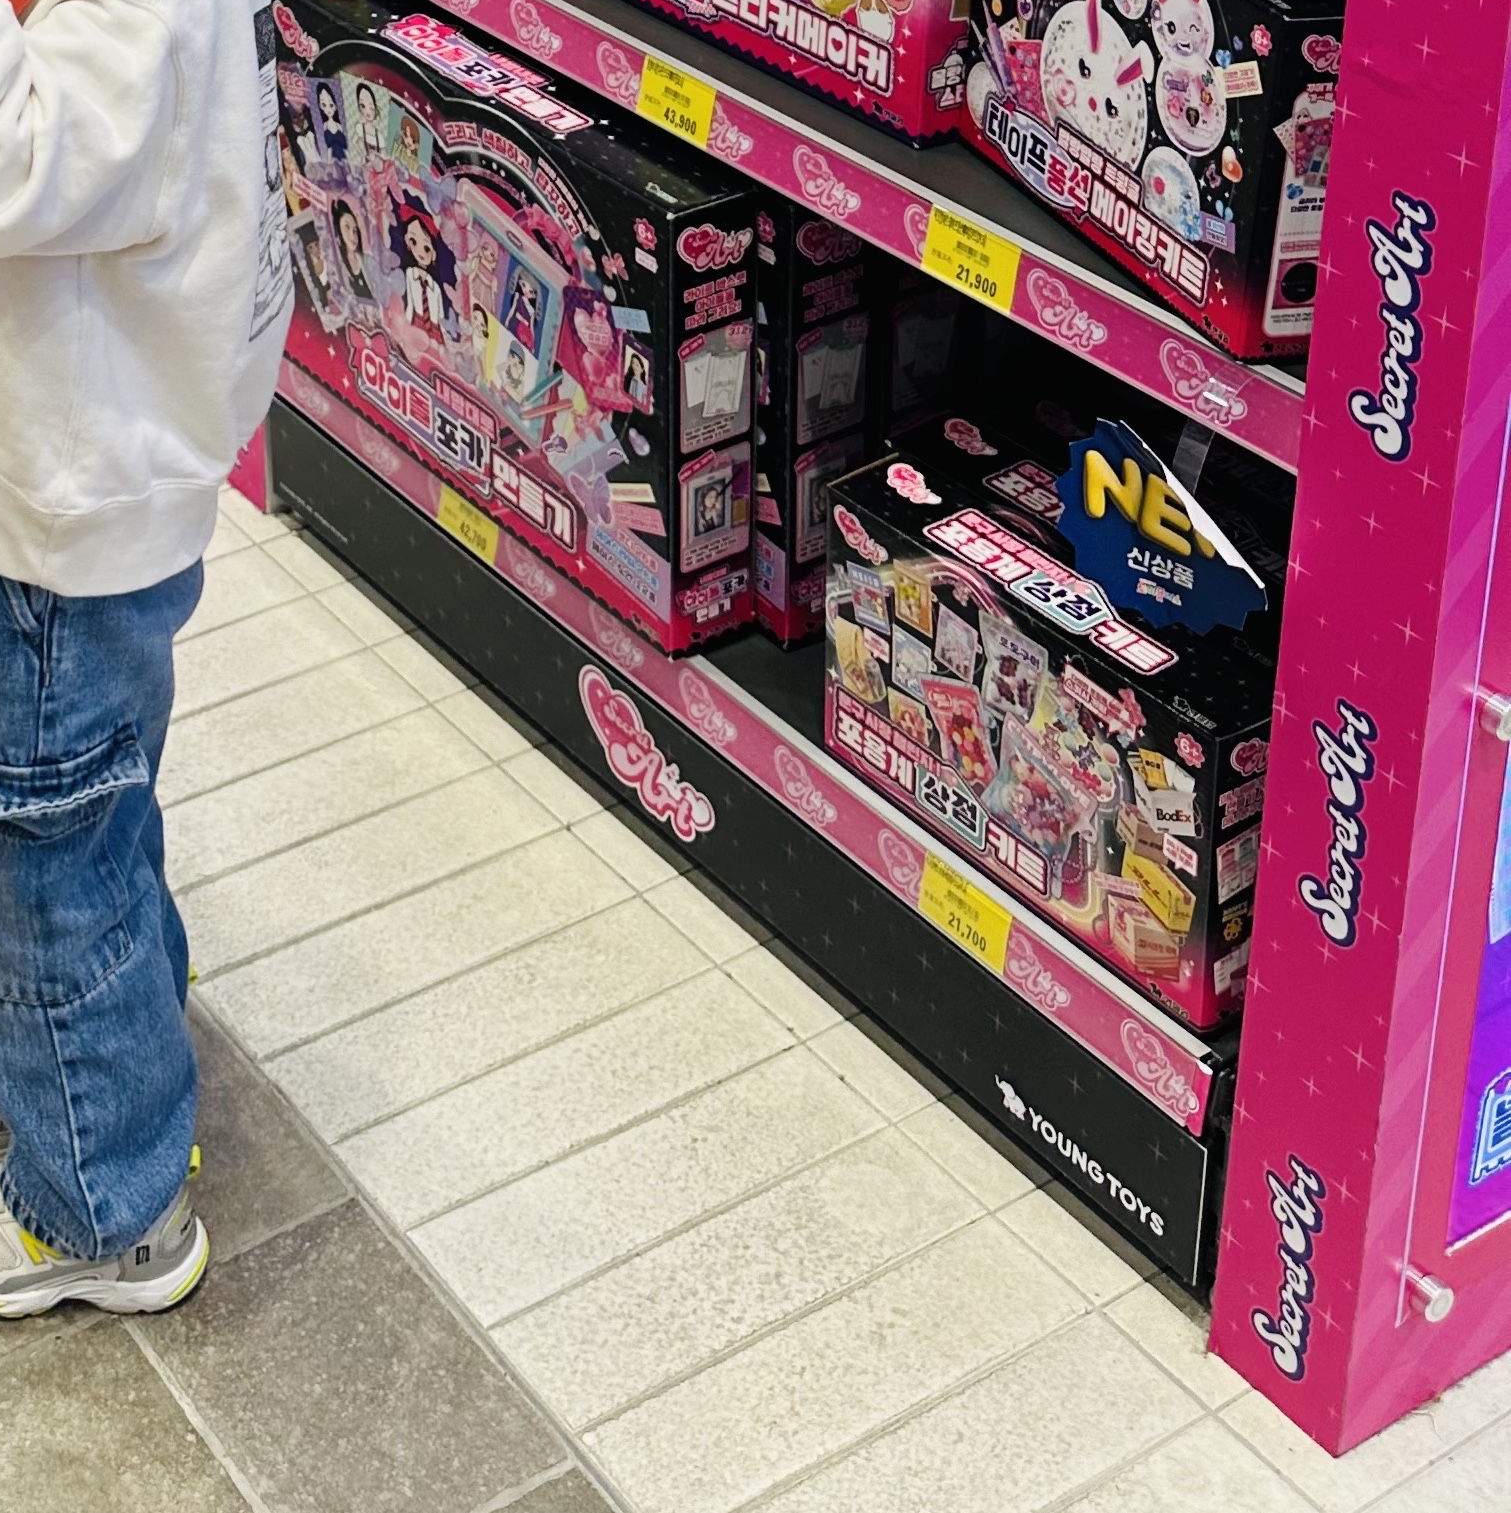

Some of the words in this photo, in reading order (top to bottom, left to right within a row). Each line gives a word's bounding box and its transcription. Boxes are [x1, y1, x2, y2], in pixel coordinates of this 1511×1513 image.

[396, 24, 477, 66] 아이돌
[454, 57, 528, 88] 포카
[663, 106, 696, 136] 43,900
[955, 264, 997, 298] 21,900
[1367, 195, 1428, 308] Art
[1350, 308, 1415, 456] Secret
[361, 347, 433, 432] 아이돌
[436, 409, 486, 470] 포카
[491, 453, 575, 548] 만들기
[1082, 448, 1216, 559] NE
[1126, 546, 1194, 590] 신상품
[1024, 580, 1103, 622] 상점
[1093, 618, 1174, 672] 키트
[1178, 736, 1201, 757] 6+
[1314, 703, 1370, 808] Art
[838, 710, 915, 796] 포용계
[921, 774, 979, 834] 상점
[988, 821, 1047, 897] 키트
[1155, 807, 1192, 823] BodEx
[1299, 804, 1360, 941] Secret
[947, 912, 987, 952] 21,700
[1025, 1106, 1106, 1183] YOUNG
[1106, 1173, 1166, 1239] TOYS
[1267, 1159, 1320, 1254] Art
[1252, 1247, 1308, 1375] Secret
